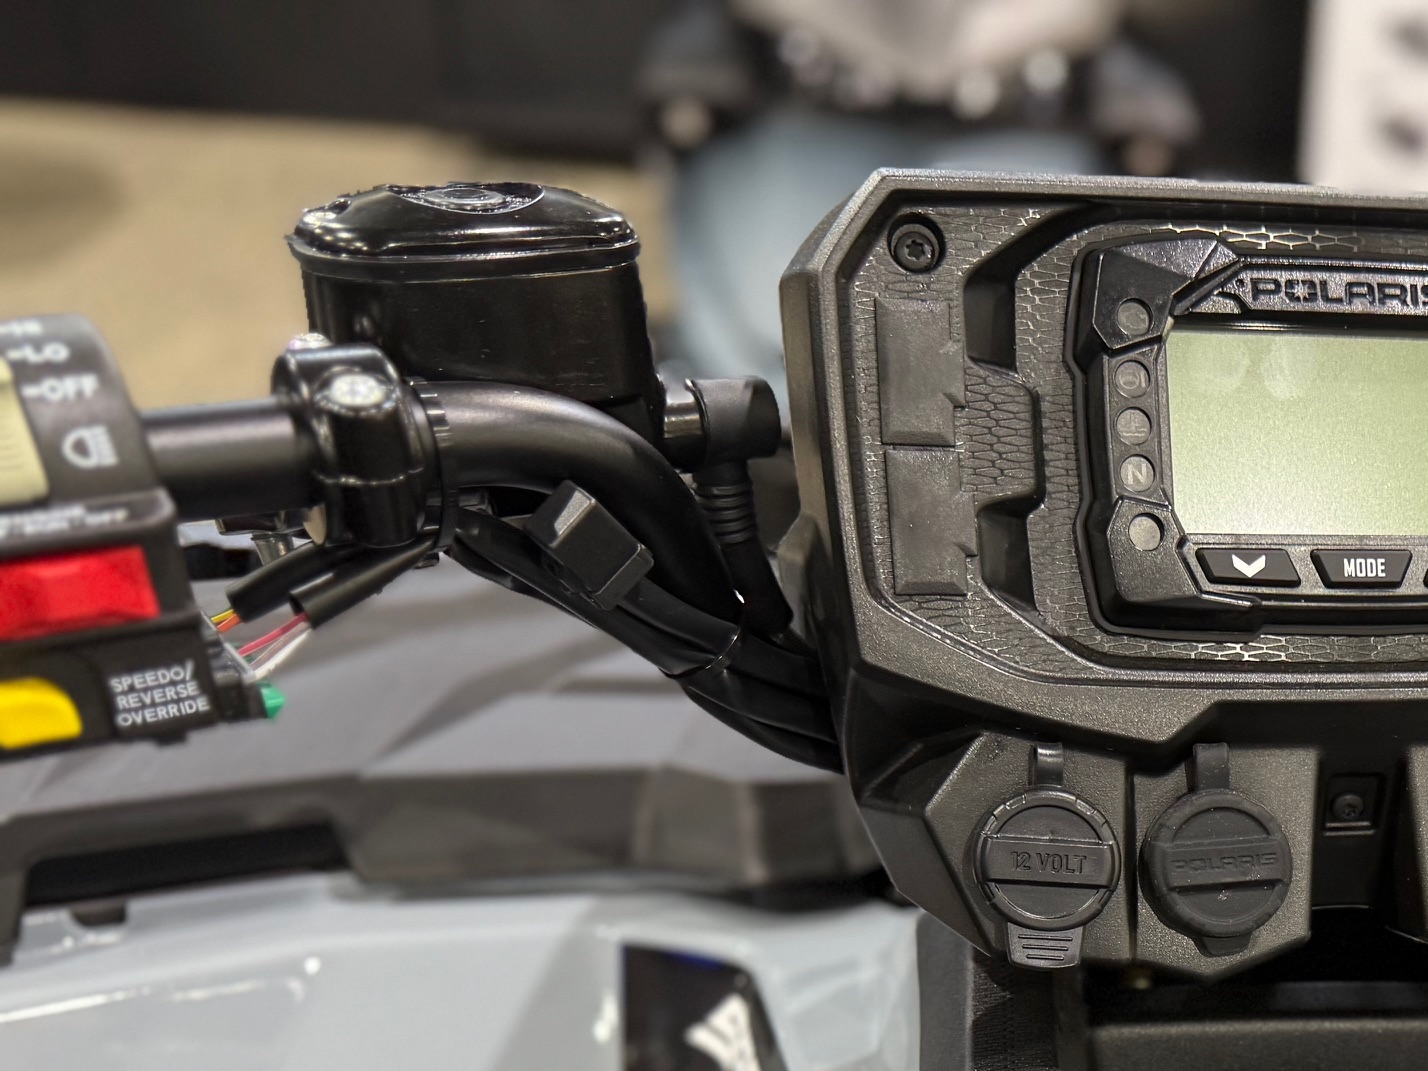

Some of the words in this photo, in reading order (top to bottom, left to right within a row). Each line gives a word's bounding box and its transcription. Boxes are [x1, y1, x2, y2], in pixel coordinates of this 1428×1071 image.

[40, 373, 100, 401] OFF
[1343, 558, 1386, 579] MODE
[110, 659, 195, 693] SPEEDO/
[116, 682, 200, 709] REVERSE
[117, 695, 211, 727] OVERRIDE
[1010, 850, 1032, 872] 12
[1036, 852, 1087, 876] VOLT
[1170, 852, 1278, 873] POLARIS
